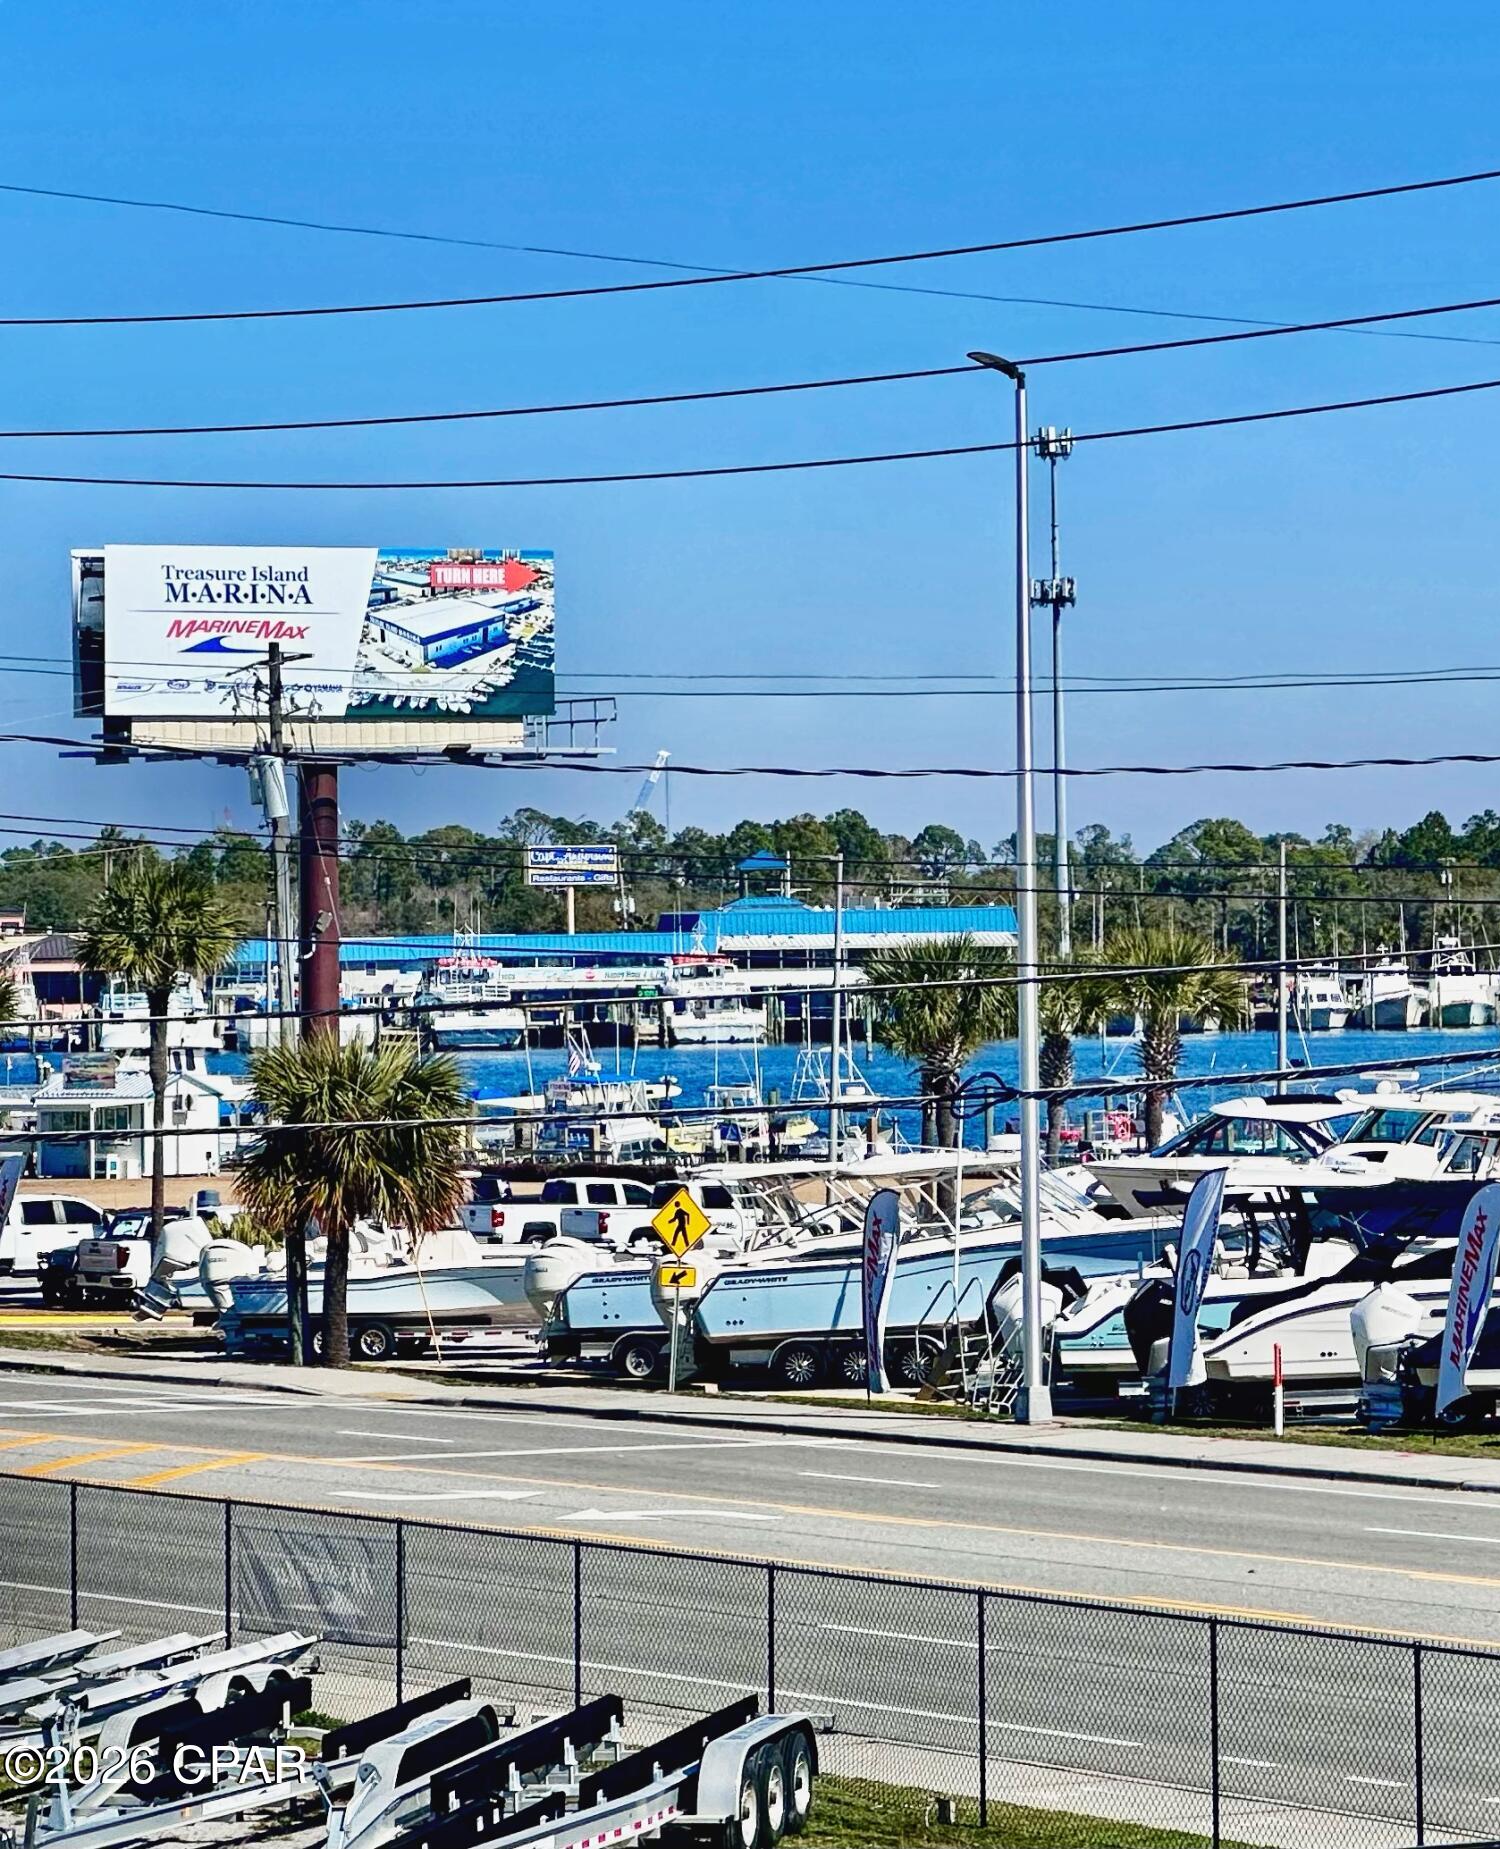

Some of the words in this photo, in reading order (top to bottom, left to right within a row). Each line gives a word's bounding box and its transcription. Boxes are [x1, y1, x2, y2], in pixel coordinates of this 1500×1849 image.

[162, 564, 247, 581] Treasure
[252, 566, 309, 582] Island
[435, 567, 471, 584] TURN
[473, 567, 505, 584] HERE
[593, 873, 614, 881] Gifts
